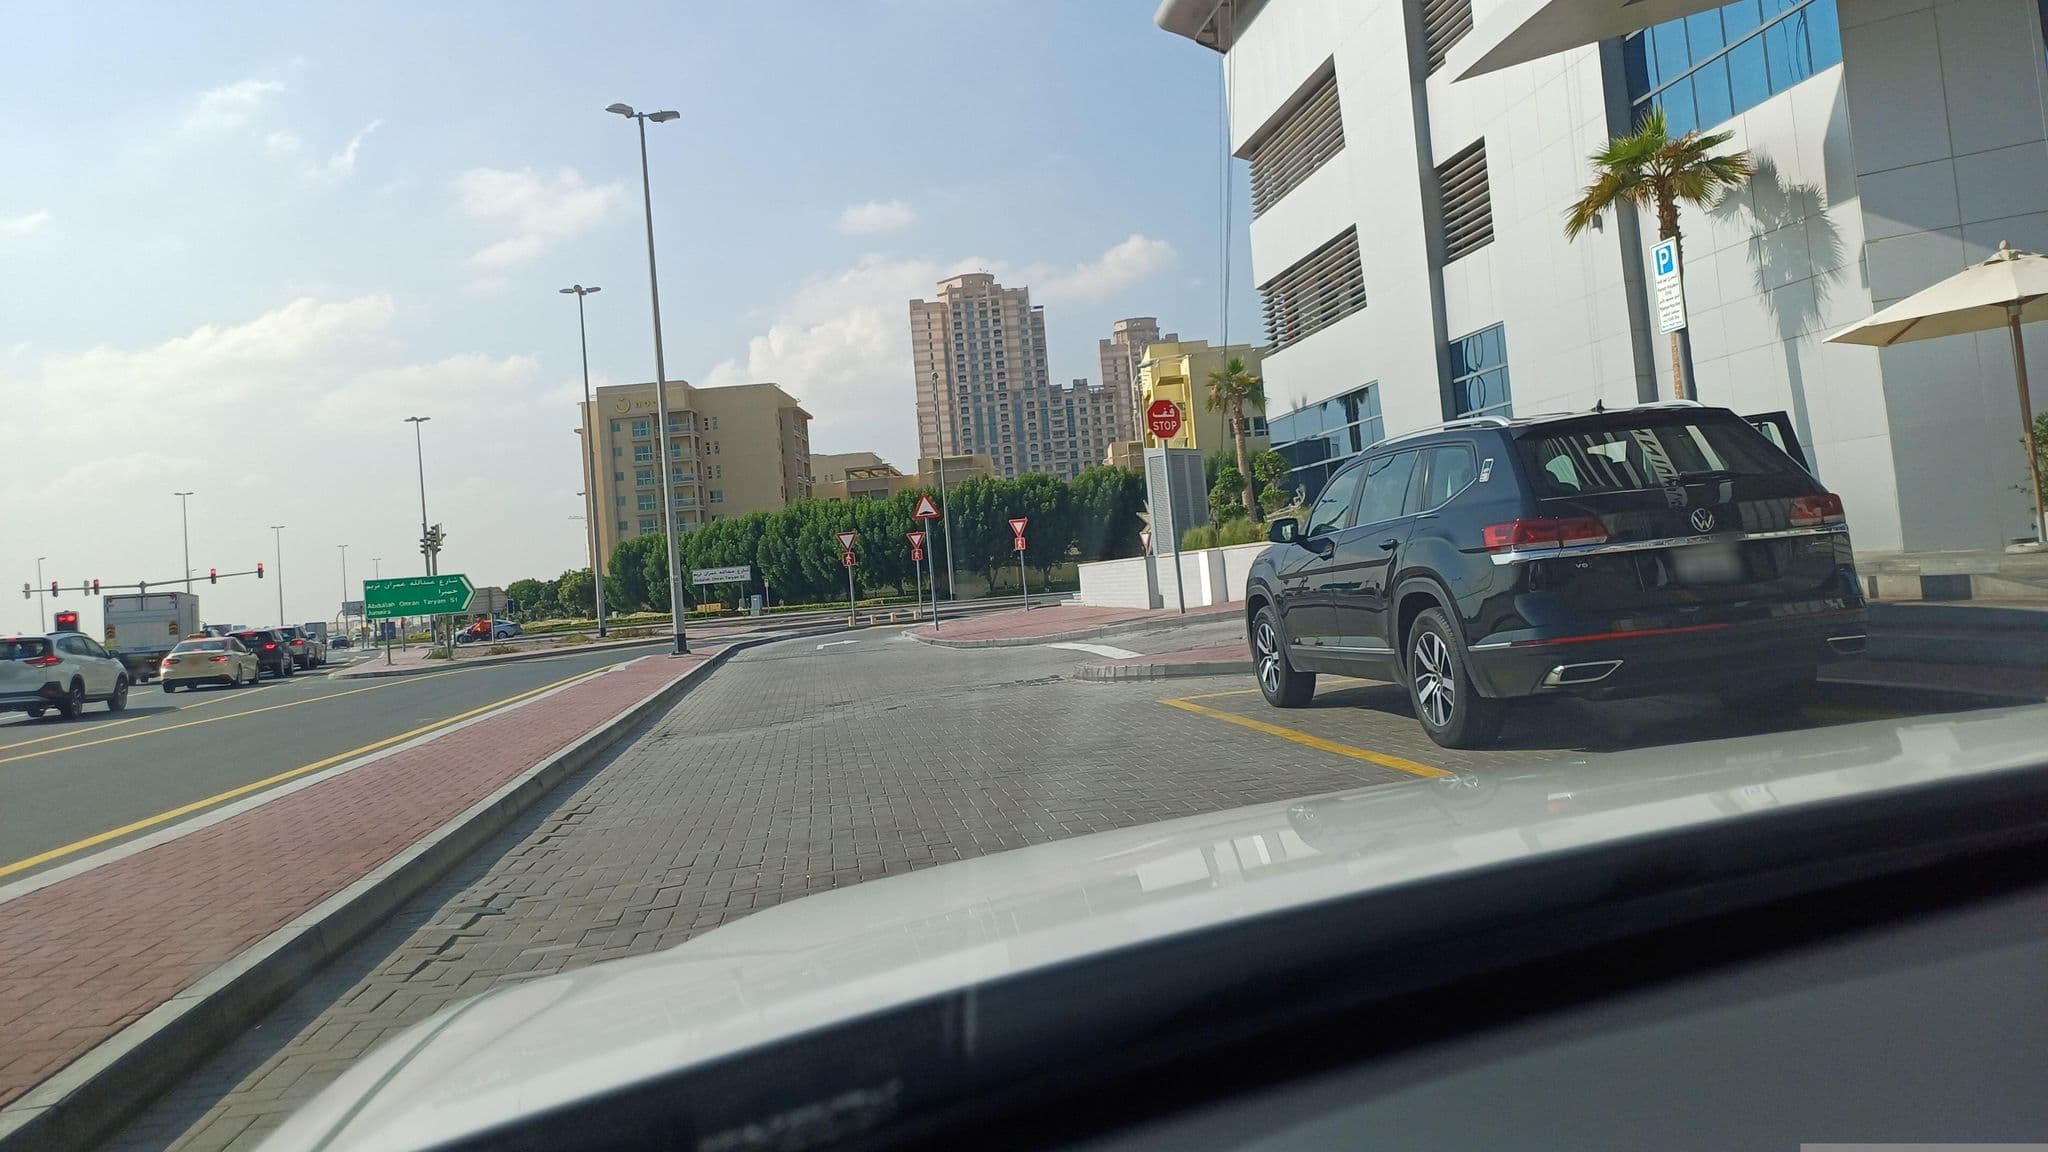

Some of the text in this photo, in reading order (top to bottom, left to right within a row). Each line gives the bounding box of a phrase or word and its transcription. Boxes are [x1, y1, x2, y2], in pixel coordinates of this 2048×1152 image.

[1658, 247, 1670, 274] P
[1152, 404, 1175, 418] قف
[1153, 420, 1177, 431] STOP
[367, 601, 395, 609] Abdullah
[399, 599, 420, 607] Omran
[424, 598, 447, 606] Taryam
